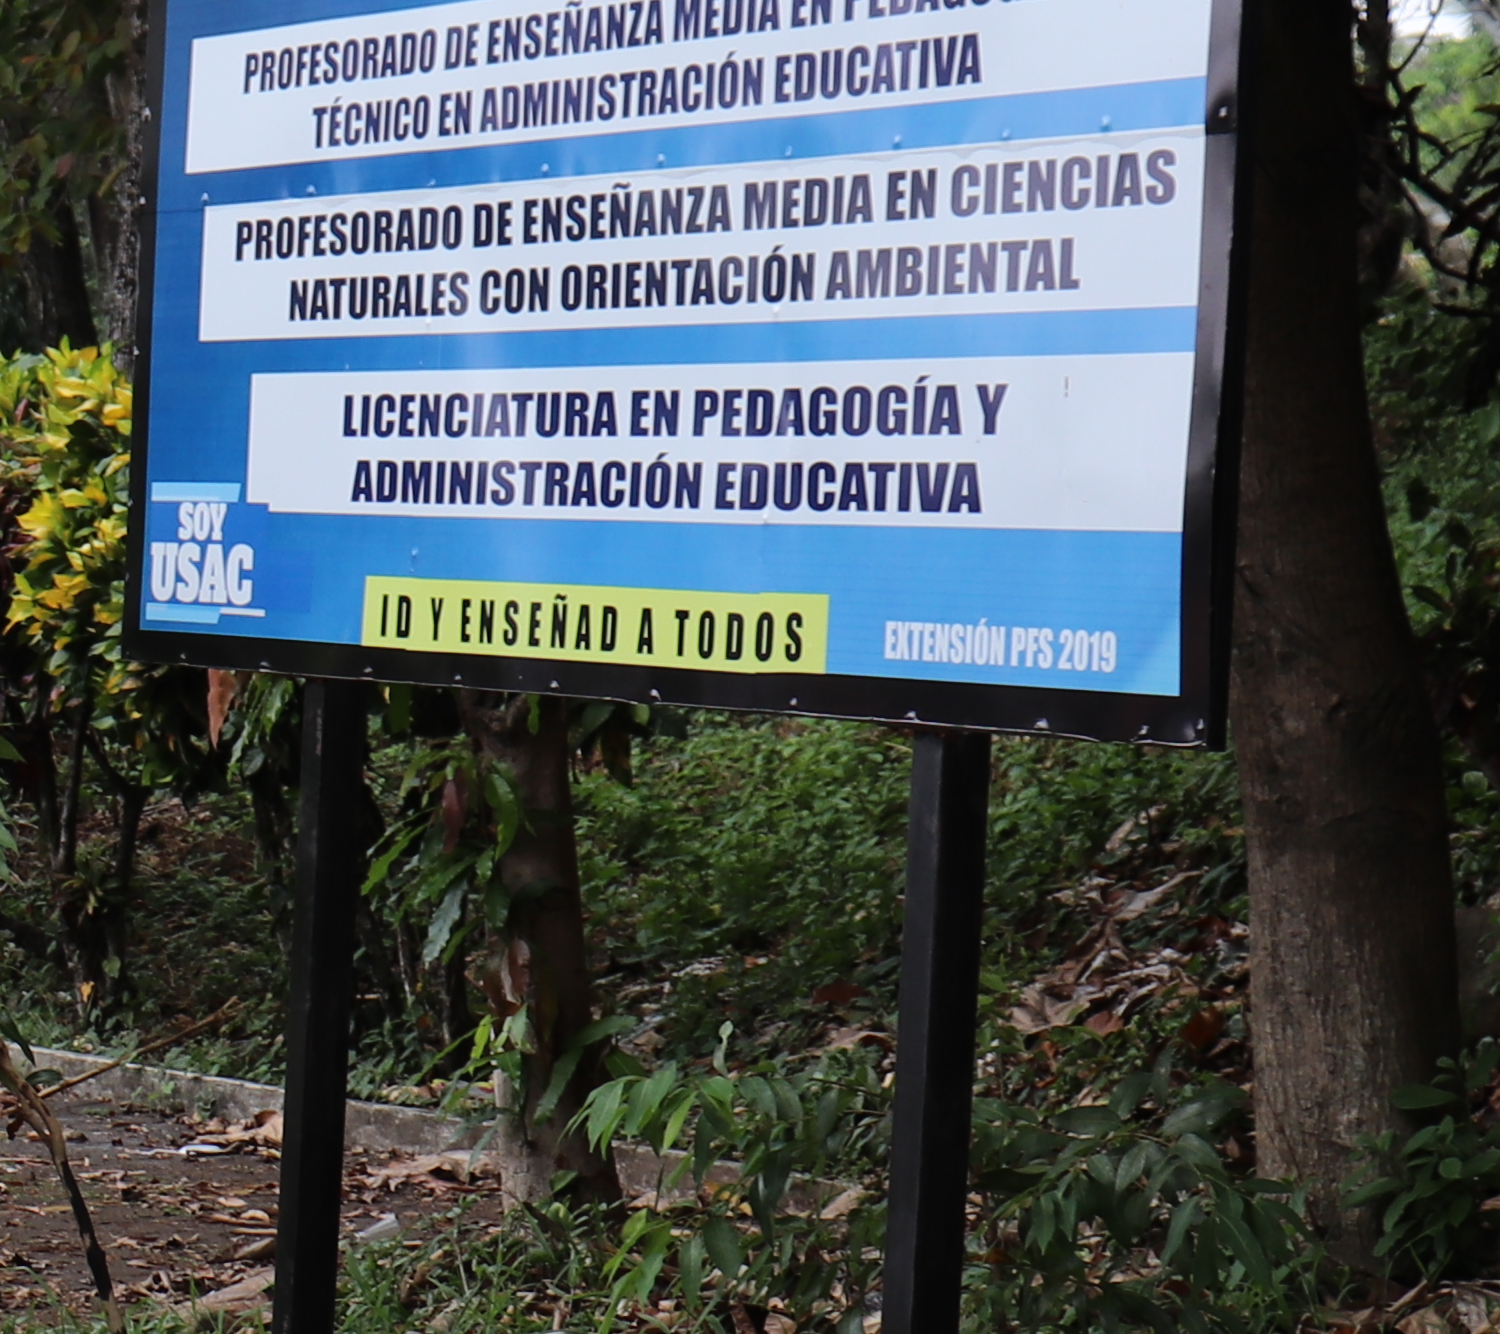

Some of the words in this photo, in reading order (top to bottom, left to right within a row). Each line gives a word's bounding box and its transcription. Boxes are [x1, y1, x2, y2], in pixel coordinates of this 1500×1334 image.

[243, 28, 437, 94] PROFESORADO
[444, 23, 479, 71] DE
[313, 97, 430, 149] TÉCNICO
[437, 90, 472, 137] EN
[479, 51, 763, 131] ADMINISTRACIÓN
[774, 32, 982, 104] EDUCATIVA
[235, 205, 462, 262] PROFESORADO
[473, 201, 512, 248] DE
[523, 182, 731, 244] ENSEÑANZA
[743, 174, 873, 230] MEDIA
[886, 168, 937, 221] EN
[950, 149, 1176, 218] CIENCIAS
[288, 271, 469, 322] NATURALES
[478, 266, 550, 315] CON
[560, 245, 816, 312] ORIENTACIÓN
[825, 237, 1080, 301] AMBIENTAL
[342, 390, 618, 438] LICENCIATURA
[629, 389, 681, 436] EN
[692, 375, 962, 437] PEDAGOGÍA
[976, 383, 1009, 435] Y
[350, 452, 703, 509] ADMINISTRACIÓN
[714, 461, 982, 513] EDUCATIVA
[178, 502, 228, 541] SOY
[150, 542, 254, 606] USAC
[380, 594, 412, 638] ID
[430, 597, 445, 641] Y
[460, 594, 618, 652] ENSEÑAD
[637, 607, 654, 655] A
[675, 609, 804, 662] TODOS
[884, 618, 1006, 666] EXTENSIÓN
[1011, 626, 1054, 669] PFS
[1057, 628, 1117, 673] 2019
